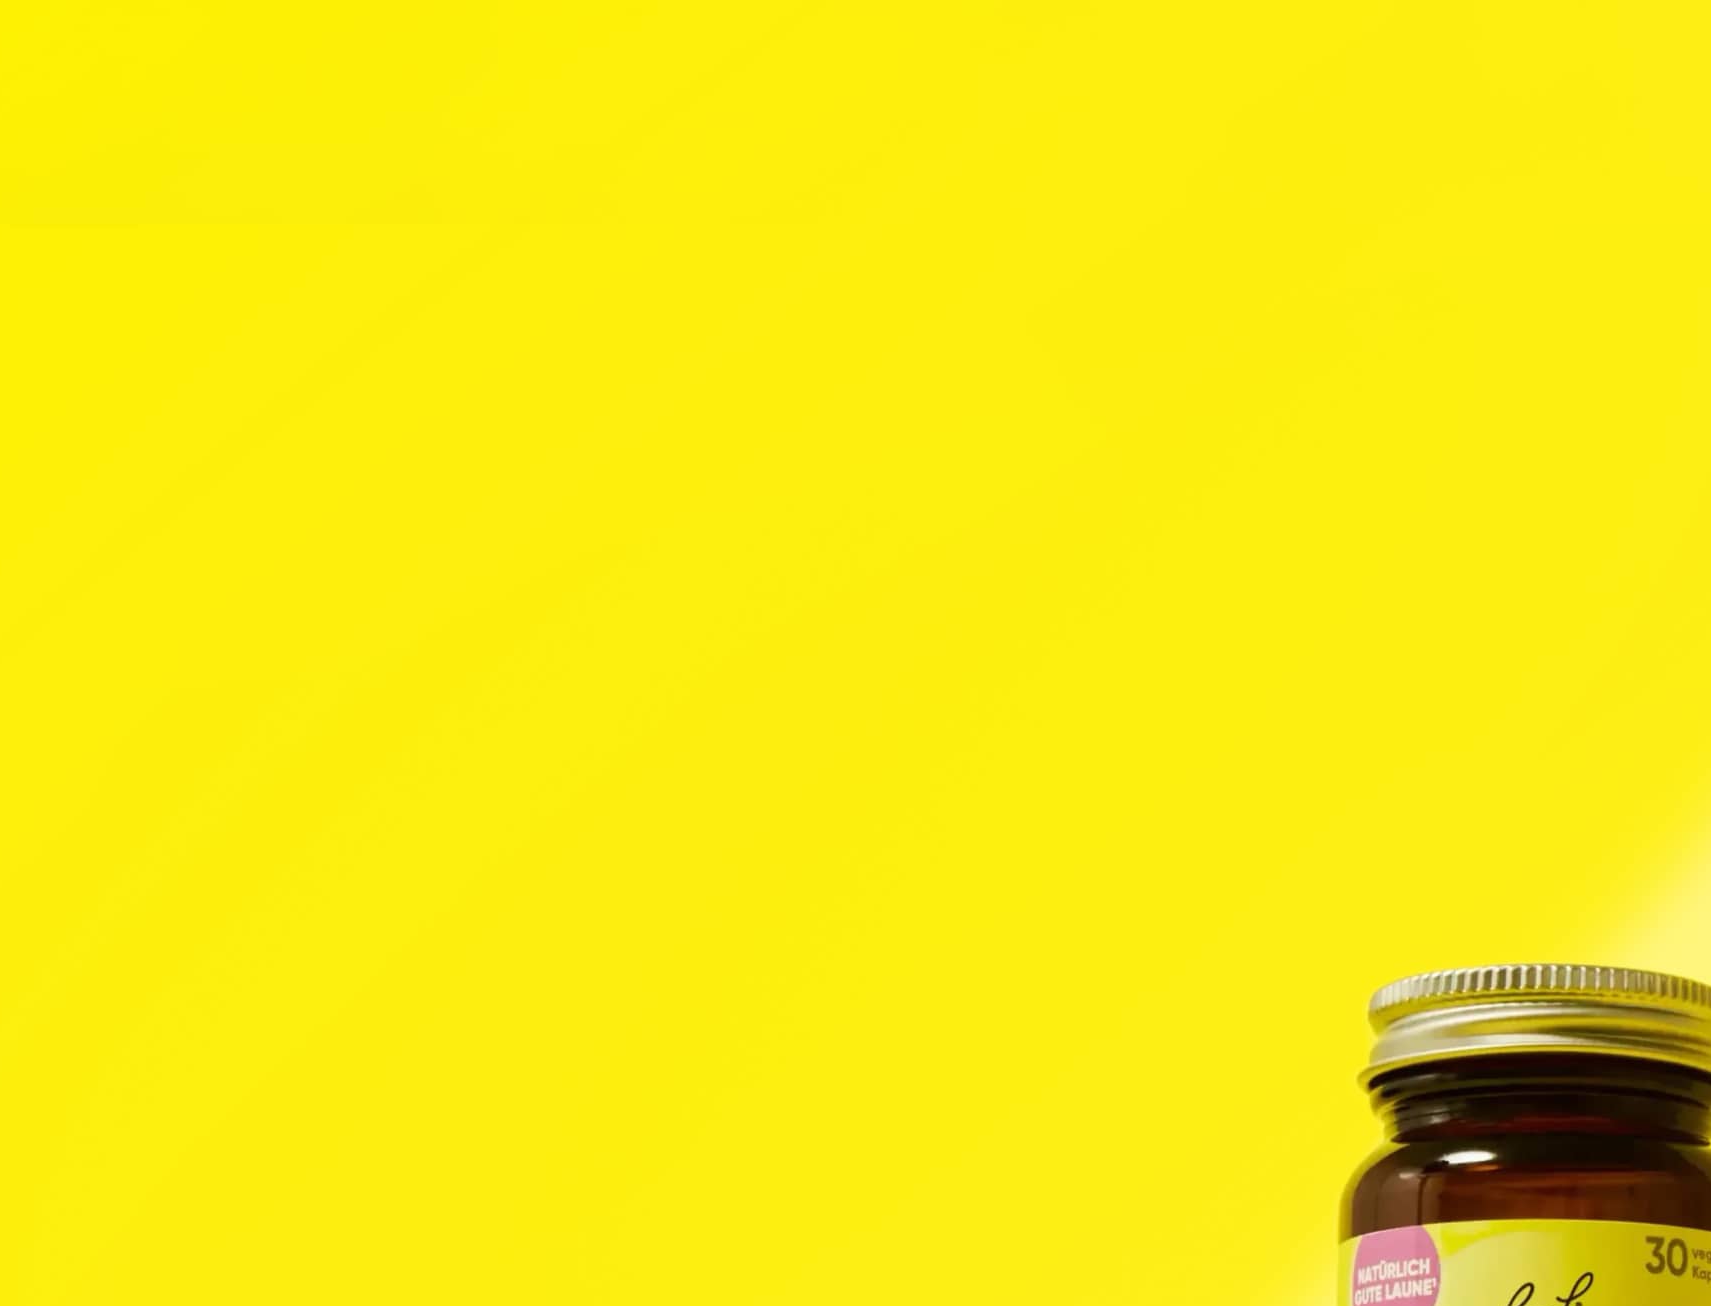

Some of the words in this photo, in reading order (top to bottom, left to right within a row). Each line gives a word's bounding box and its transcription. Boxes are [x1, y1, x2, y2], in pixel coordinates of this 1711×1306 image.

[1644, 1235, 1688, 1276] 30
[1357, 1257, 1431, 1287] NATÜRLICH
[1354, 1285, 1383, 1306] GUTE
